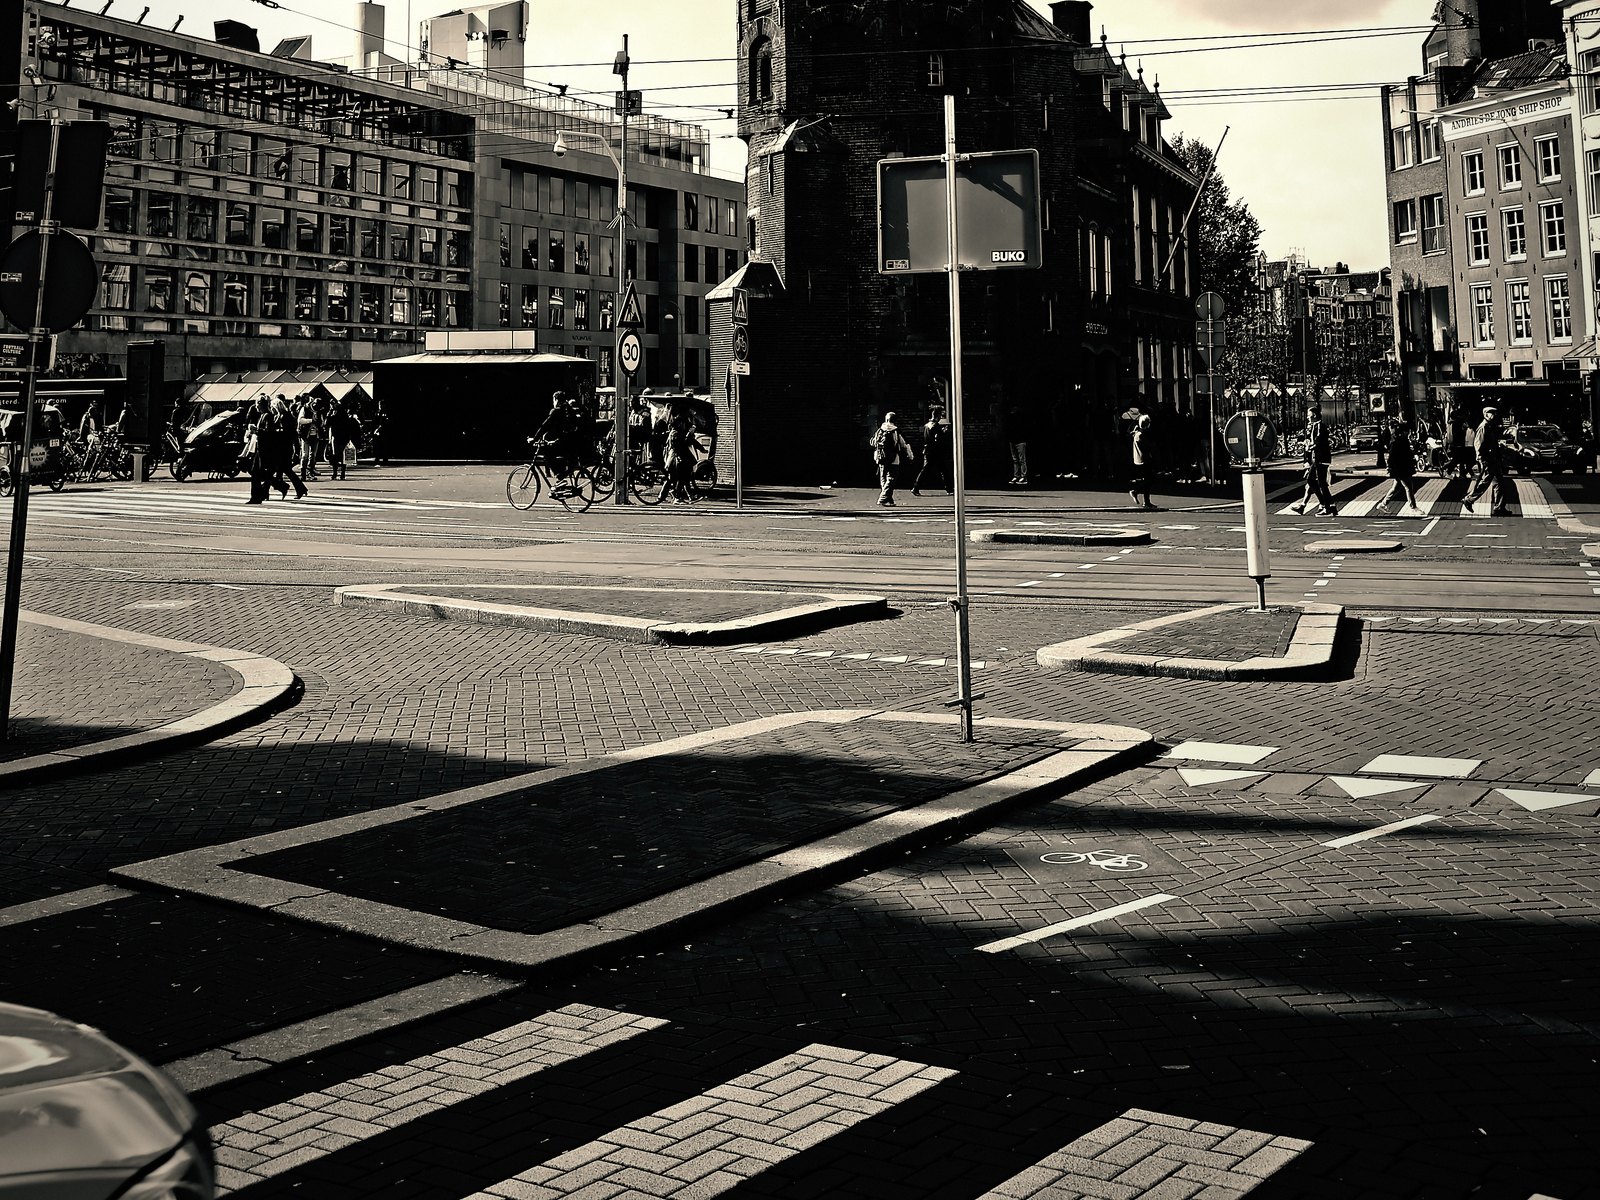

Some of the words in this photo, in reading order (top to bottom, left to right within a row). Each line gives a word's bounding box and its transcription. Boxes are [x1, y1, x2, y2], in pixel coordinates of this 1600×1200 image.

[1451, 115, 1484, 131] ANDRIES
[1484, 112, 1496, 122] DE
[1496, 107, 1517, 120] JONG
[1518, 102, 1539, 115] SHIP
[1539, 96, 1562, 111] SHOP
[992, 251, 1025, 261] BUKO
[623, 342, 639, 362] 30
